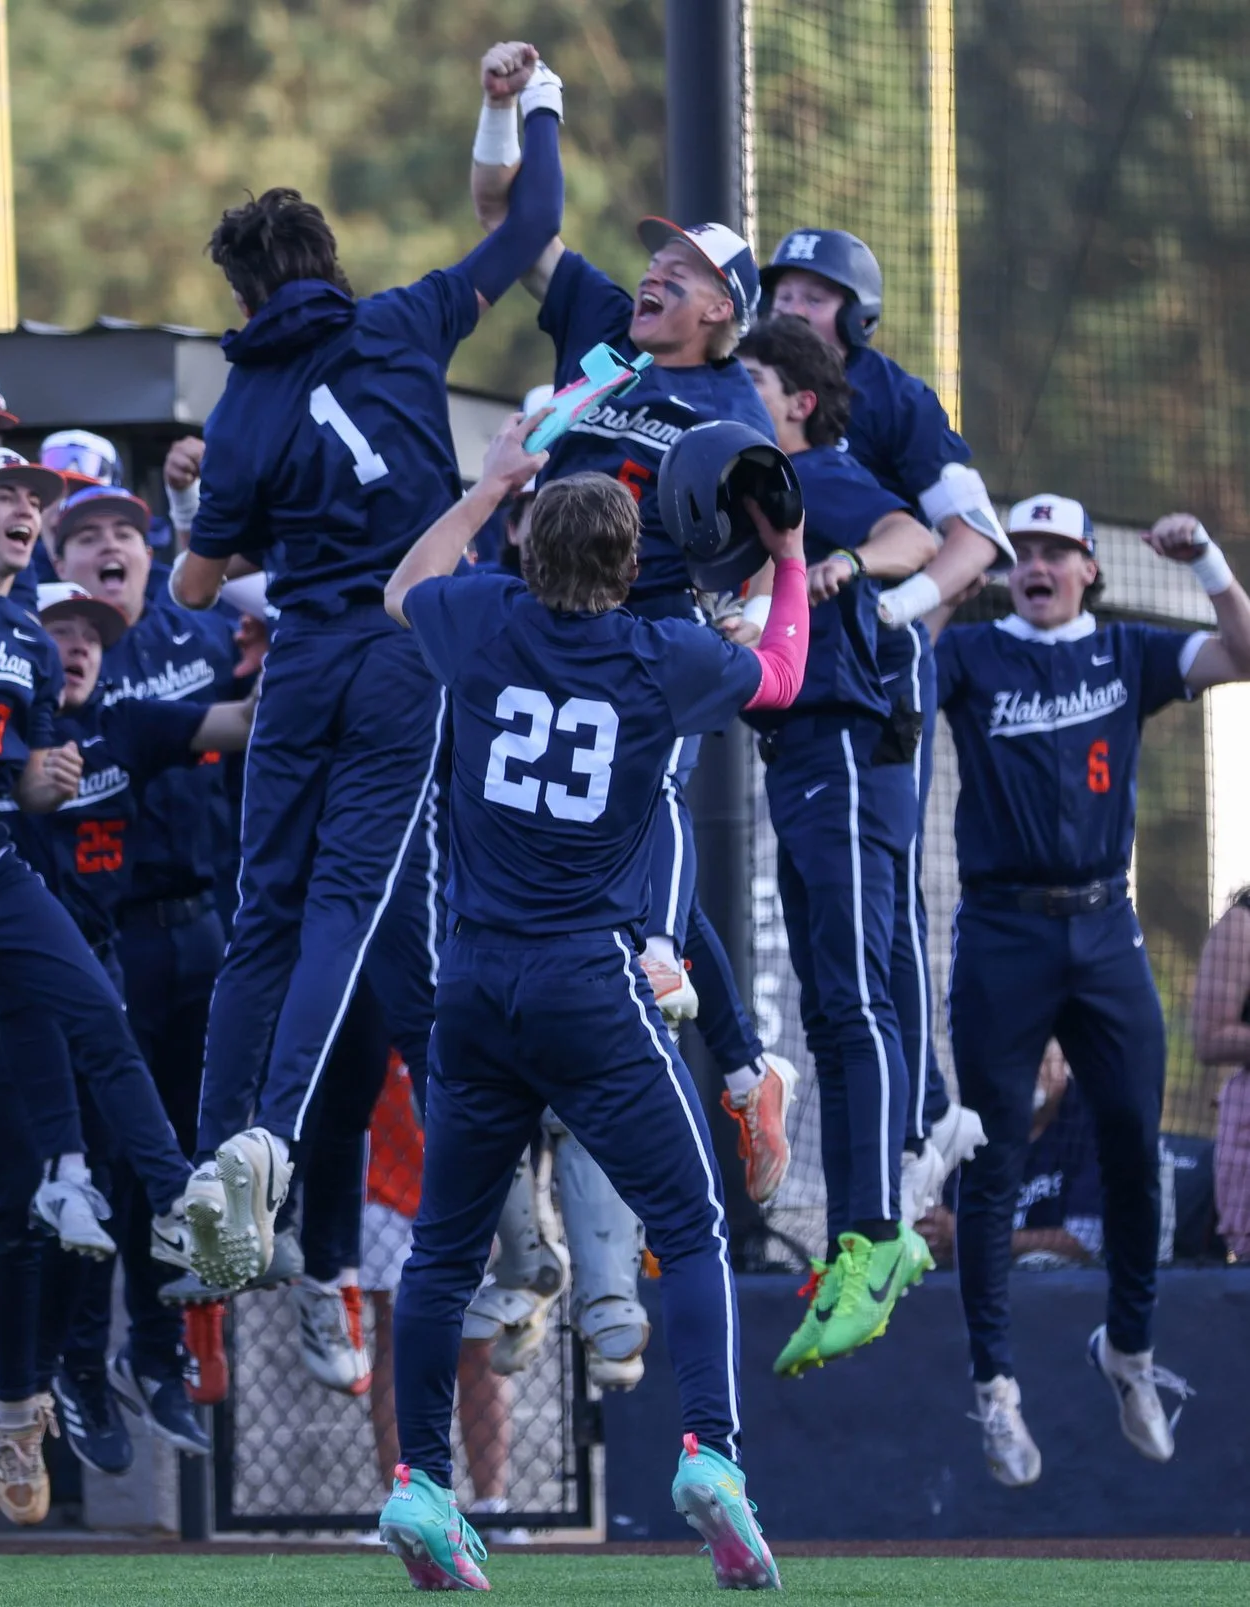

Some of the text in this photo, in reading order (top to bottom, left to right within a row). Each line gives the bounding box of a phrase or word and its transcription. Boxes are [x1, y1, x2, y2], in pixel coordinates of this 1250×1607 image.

[309, 383, 389, 486] 1
[582, 405, 683, 446] ersham
[989, 678, 1128, 730] Habersham
[484, 685, 620, 823] 23
[1087, 740, 1111, 793] 6
[76, 820, 126, 873] 25
